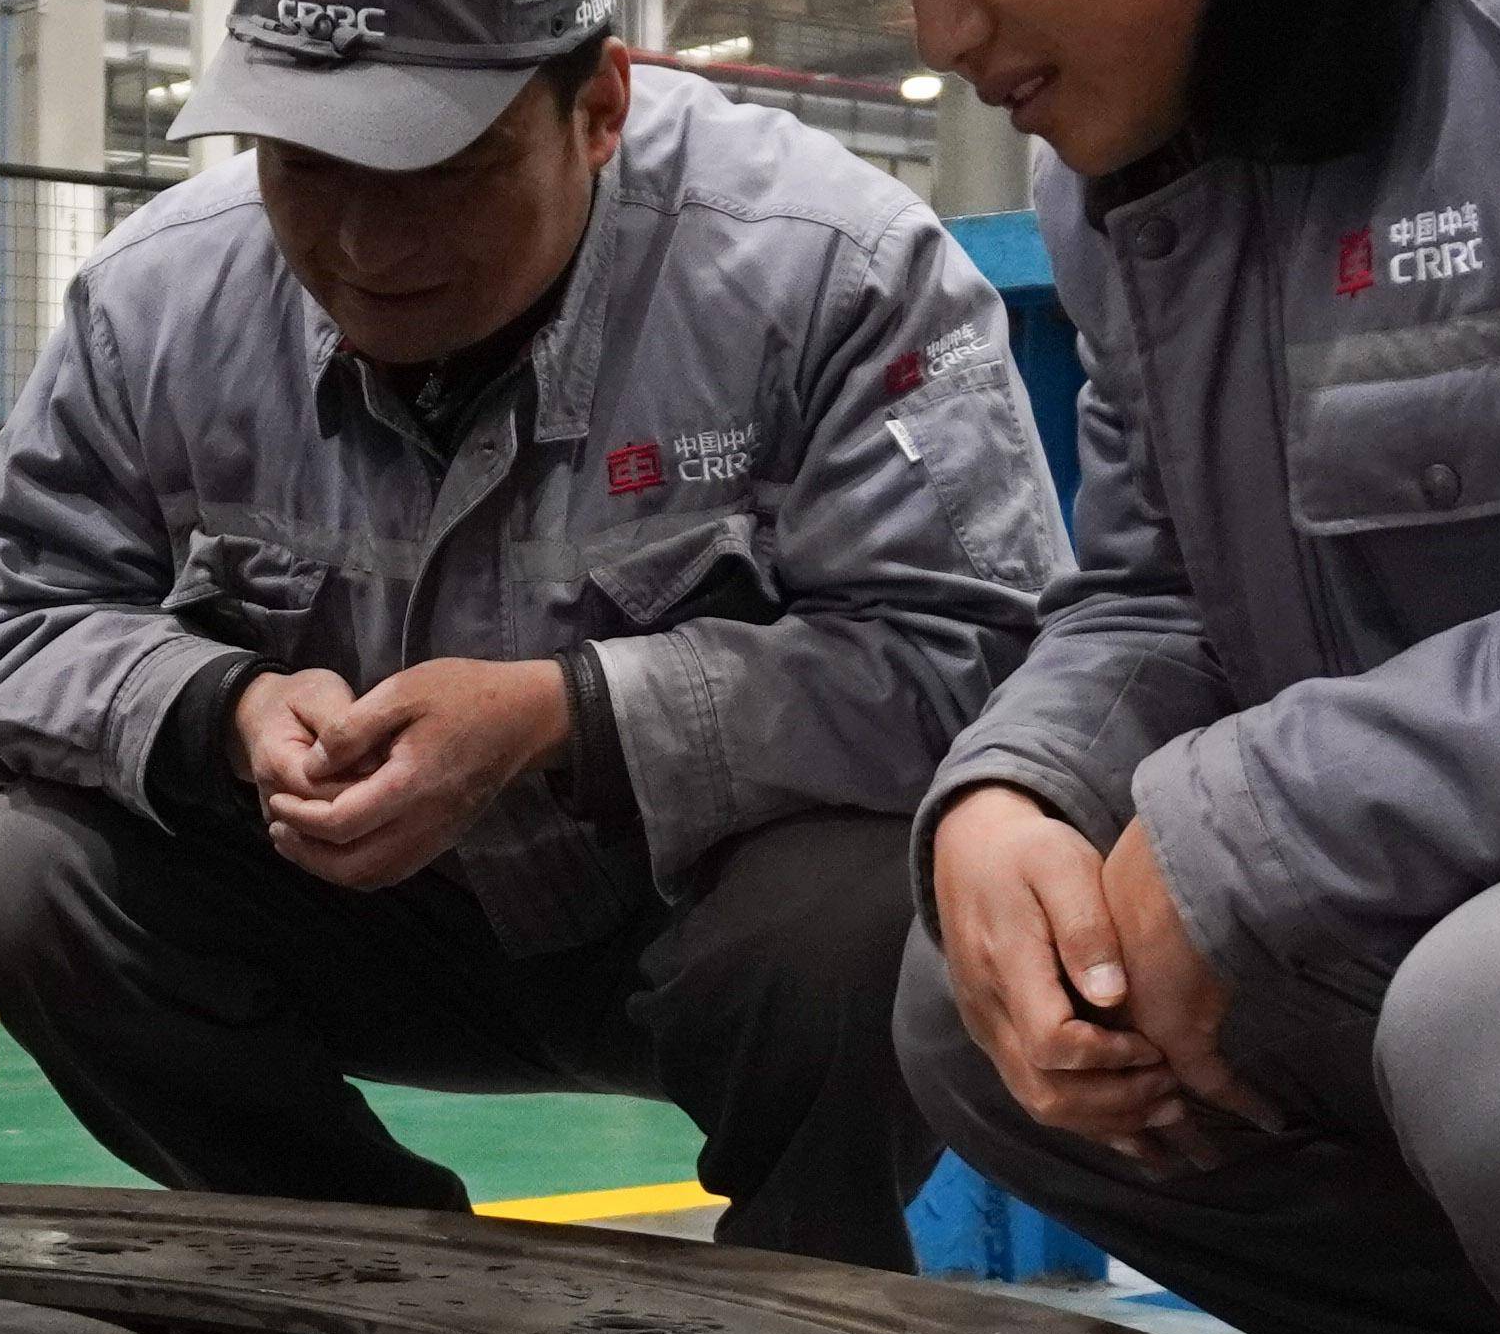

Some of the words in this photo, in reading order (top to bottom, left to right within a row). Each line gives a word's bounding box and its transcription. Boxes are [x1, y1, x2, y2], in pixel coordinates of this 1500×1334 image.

[1390, 201, 1479, 246] 中国中车
[1390, 238, 1483, 284] CRRC
[927, 335, 993, 376] CRRC
[679, 452, 748, 481] CRR
